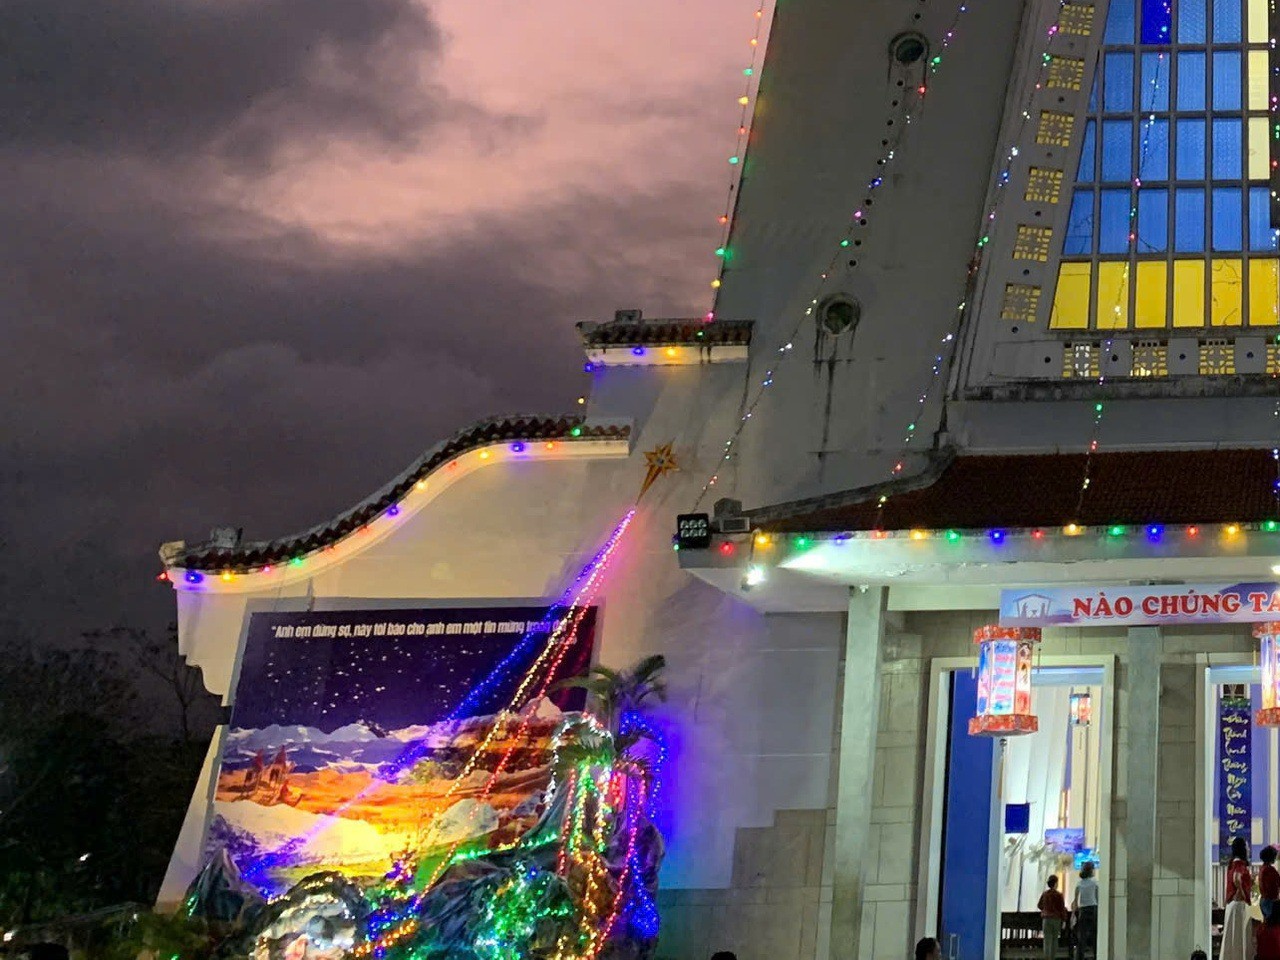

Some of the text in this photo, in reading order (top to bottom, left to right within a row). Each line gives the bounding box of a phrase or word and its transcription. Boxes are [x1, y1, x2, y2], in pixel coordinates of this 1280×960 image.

[1073, 592, 1133, 617] NÀO
[1142, 589, 1241, 616] CHÚNG
[295, 625, 312, 638] em
[406, 622, 425, 635] cho
[425, 621, 445, 635] anh
[445, 623, 463, 635] em
